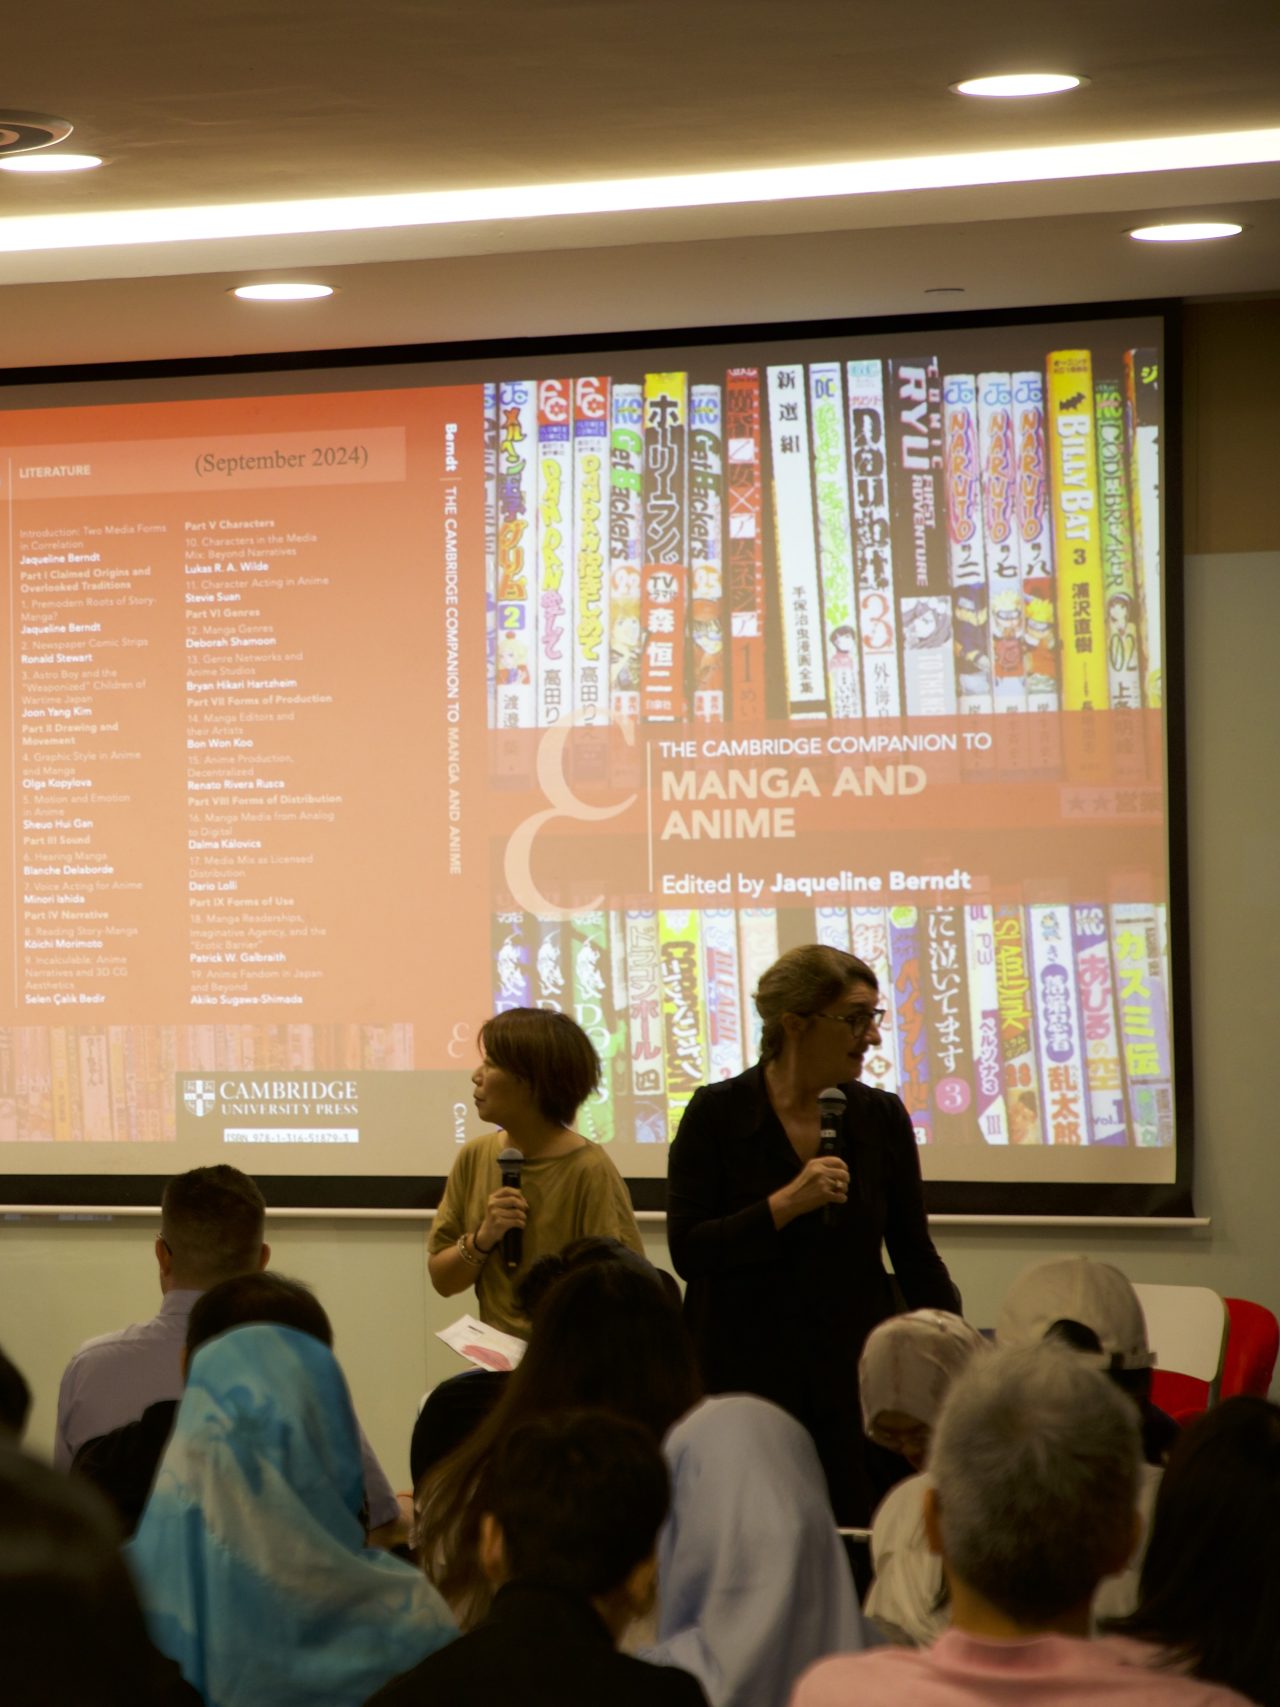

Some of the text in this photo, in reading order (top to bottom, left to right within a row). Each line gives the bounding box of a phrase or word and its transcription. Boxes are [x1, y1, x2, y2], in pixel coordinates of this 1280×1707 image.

[195, 445, 369, 476] (September 2024)
[19, 464, 91, 478] LITERATURE
[950, 409, 976, 542] NARUTO
[990, 410, 1009, 543] NARUTO
[1021, 409, 1042, 542] NARUTO
[1057, 415, 1093, 542] BILLY BAT
[184, 518, 275, 530] Part V Characters
[20, 552, 100, 565] Jaqueline Berndt
[1073, 549, 1086, 565] 3
[20, 571, 40, 579] Part
[50, 569, 90, 578] Claimed
[92, 567, 128, 580] Origins
[132, 566, 150, 576] and
[184, 562, 212, 573] Lukas
[240, 561, 268, 571] Wilde
[20, 580, 130, 592] Overlooked Traditions
[184, 591, 240, 602] Stevie Suan
[185, 609, 208, 618] Part
[223, 607, 260, 616] Genres
[862, 593, 893, 649] 3
[21, 622, 101, 635] Jaqueline Berndt
[185, 636, 276, 647] Deborah Shamoon
[445, 424, 462, 875] Berndt THE CAMBRIDGE COMPANION TO MANGA AND ANIME
[21, 652, 92, 663] Ronald Stewart
[186, 678, 297, 692] Bryan Hikari Hartzheim
[186, 697, 208, 706] Part
[227, 696, 259, 705] Forms
[262, 696, 272, 704] of
[275, 694, 333, 704] Production
[22, 707, 92, 719] Joon Yang Kim
[22, 724, 44, 732] Part
[54, 722, 96, 733] Drawing
[99, 722, 118, 730] and
[22, 736, 75, 745] Movement
[186, 738, 254, 748] Bon Won Koo
[659, 732, 992, 759] THE CAMBRIDGE COMPANION TO
[22, 777, 92, 790] Olga Kopylova
[186, 778, 284, 789] Renato Rivera Rusca
[662, 765, 927, 801] MANGA AND
[188, 797, 208, 806] Part
[232, 796, 263, 805] Forms
[266, 795, 277, 804] of
[280, 794, 342, 804] Distribution
[22, 818, 93, 829] Sheuo Hui Gan
[660, 808, 796, 840] ANIME
[23, 836, 44, 845] Part
[59, 835, 90, 844] Sound
[188, 839, 219, 849] Dalma
[23, 865, 114, 875] Blanche Delaborde
[188, 880, 237, 890] Dario Lolli
[662, 869, 971, 898] Edited by Jaqueline Berndt
[24, 894, 86, 904] Minori Ishida
[189, 898, 210, 907] Part
[226, 897, 259, 906] Forms
[261, 897, 272, 906] of
[274, 897, 294, 906] Use
[24, 911, 46, 920] Part
[61, 910, 108, 919] Narrative
[55, 939, 103, 948] Morimoto
[190, 952, 222, 962] Patrick
[240, 952, 286, 962] Galbraith
[926, 905, 963, 1073] に泣いてます
[24, 994, 50, 1003] Selen
[79, 993, 105, 1003] Bedir
[190, 994, 218, 1004] Akiko
[220, 1081, 358, 1100] CAMBRIDGE
[944, 1083, 962, 1107] 3
[221, 1104, 359, 1115] UNIVERSITY PRESS
[226, 1133, 248, 1143] ISBN
